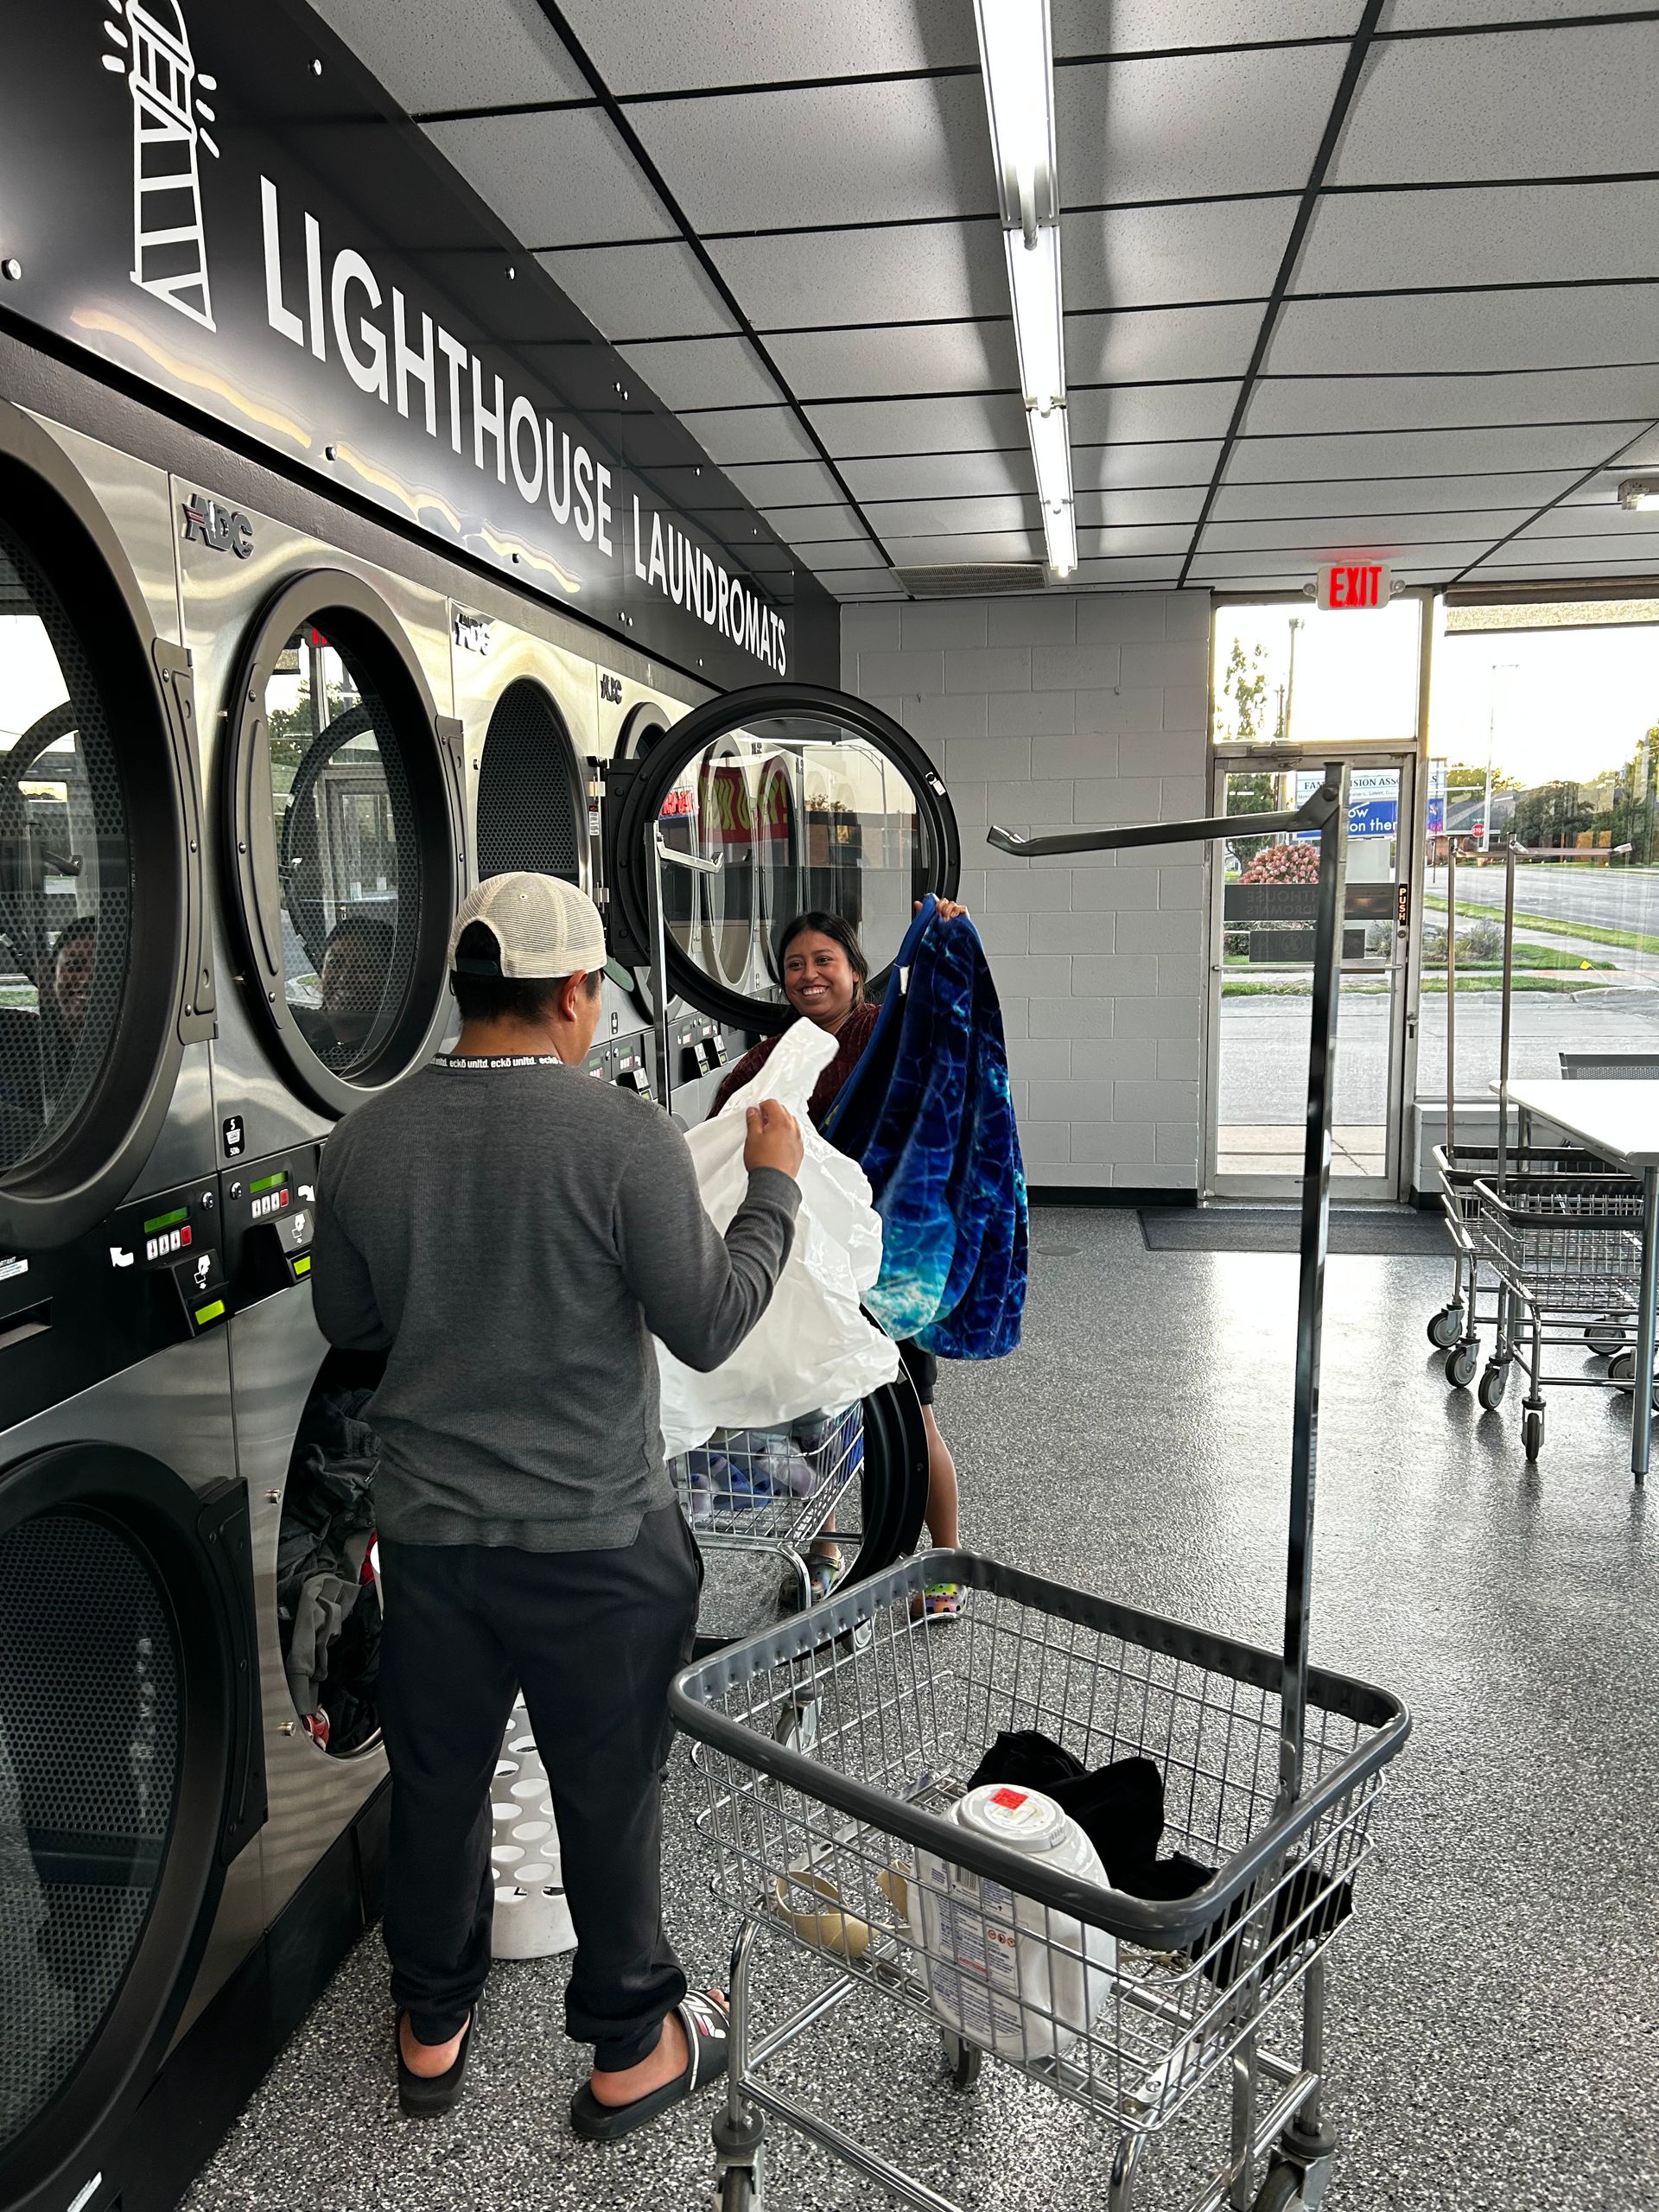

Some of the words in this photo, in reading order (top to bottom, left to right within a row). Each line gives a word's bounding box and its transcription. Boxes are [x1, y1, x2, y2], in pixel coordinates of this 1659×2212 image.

[260, 175, 613, 557] LIGHTHOUSE
[632, 493, 787, 677] LAUNDROMATS
[182, 493, 255, 559] ADC
[1330, 567, 1382, 607] EXIT
[1398, 887, 1408, 921] PUSH
